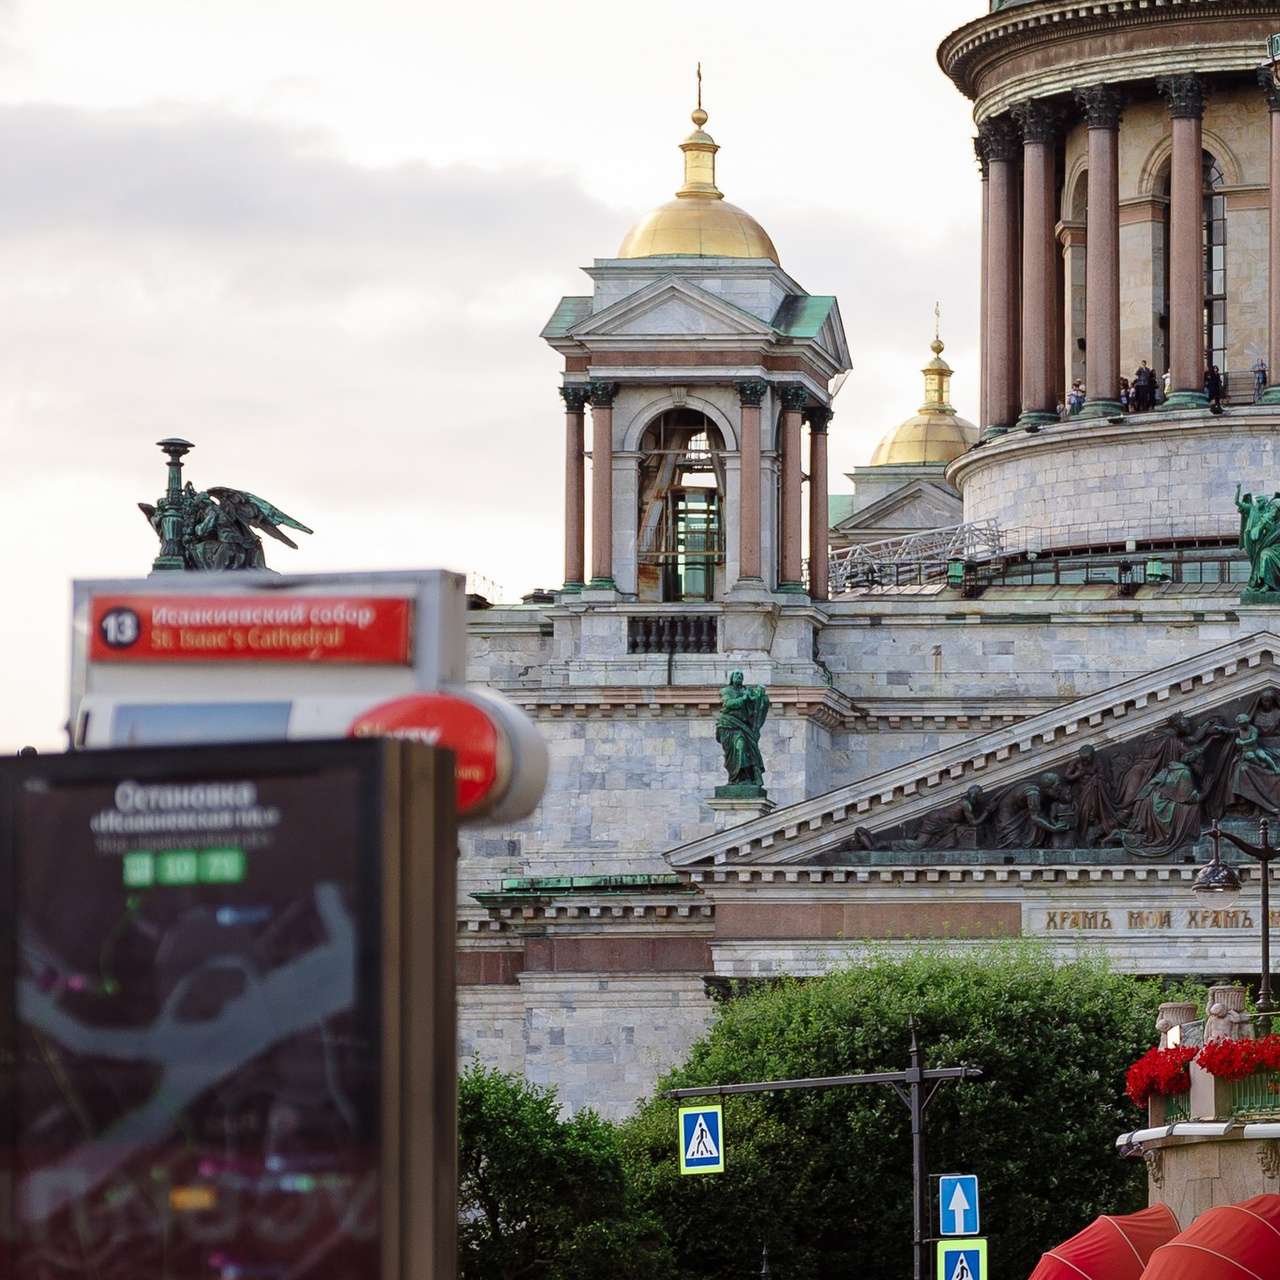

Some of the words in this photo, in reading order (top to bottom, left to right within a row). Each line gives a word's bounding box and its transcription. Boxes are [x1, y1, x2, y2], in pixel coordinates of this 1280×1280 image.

[103, 614, 136, 643] 13
[151, 604, 304, 626] Исаакиевский
[310, 605, 376, 629] собор
[151, 629, 174, 649] St.
[180, 627, 242, 649] Isaac's
[248, 627, 341, 648] Cathedral
[114, 780, 257, 811] Остановка
[1045, 910, 1112, 930] ХРАМЪ
[1185, 909, 1253, 929] ХРАМЪ
